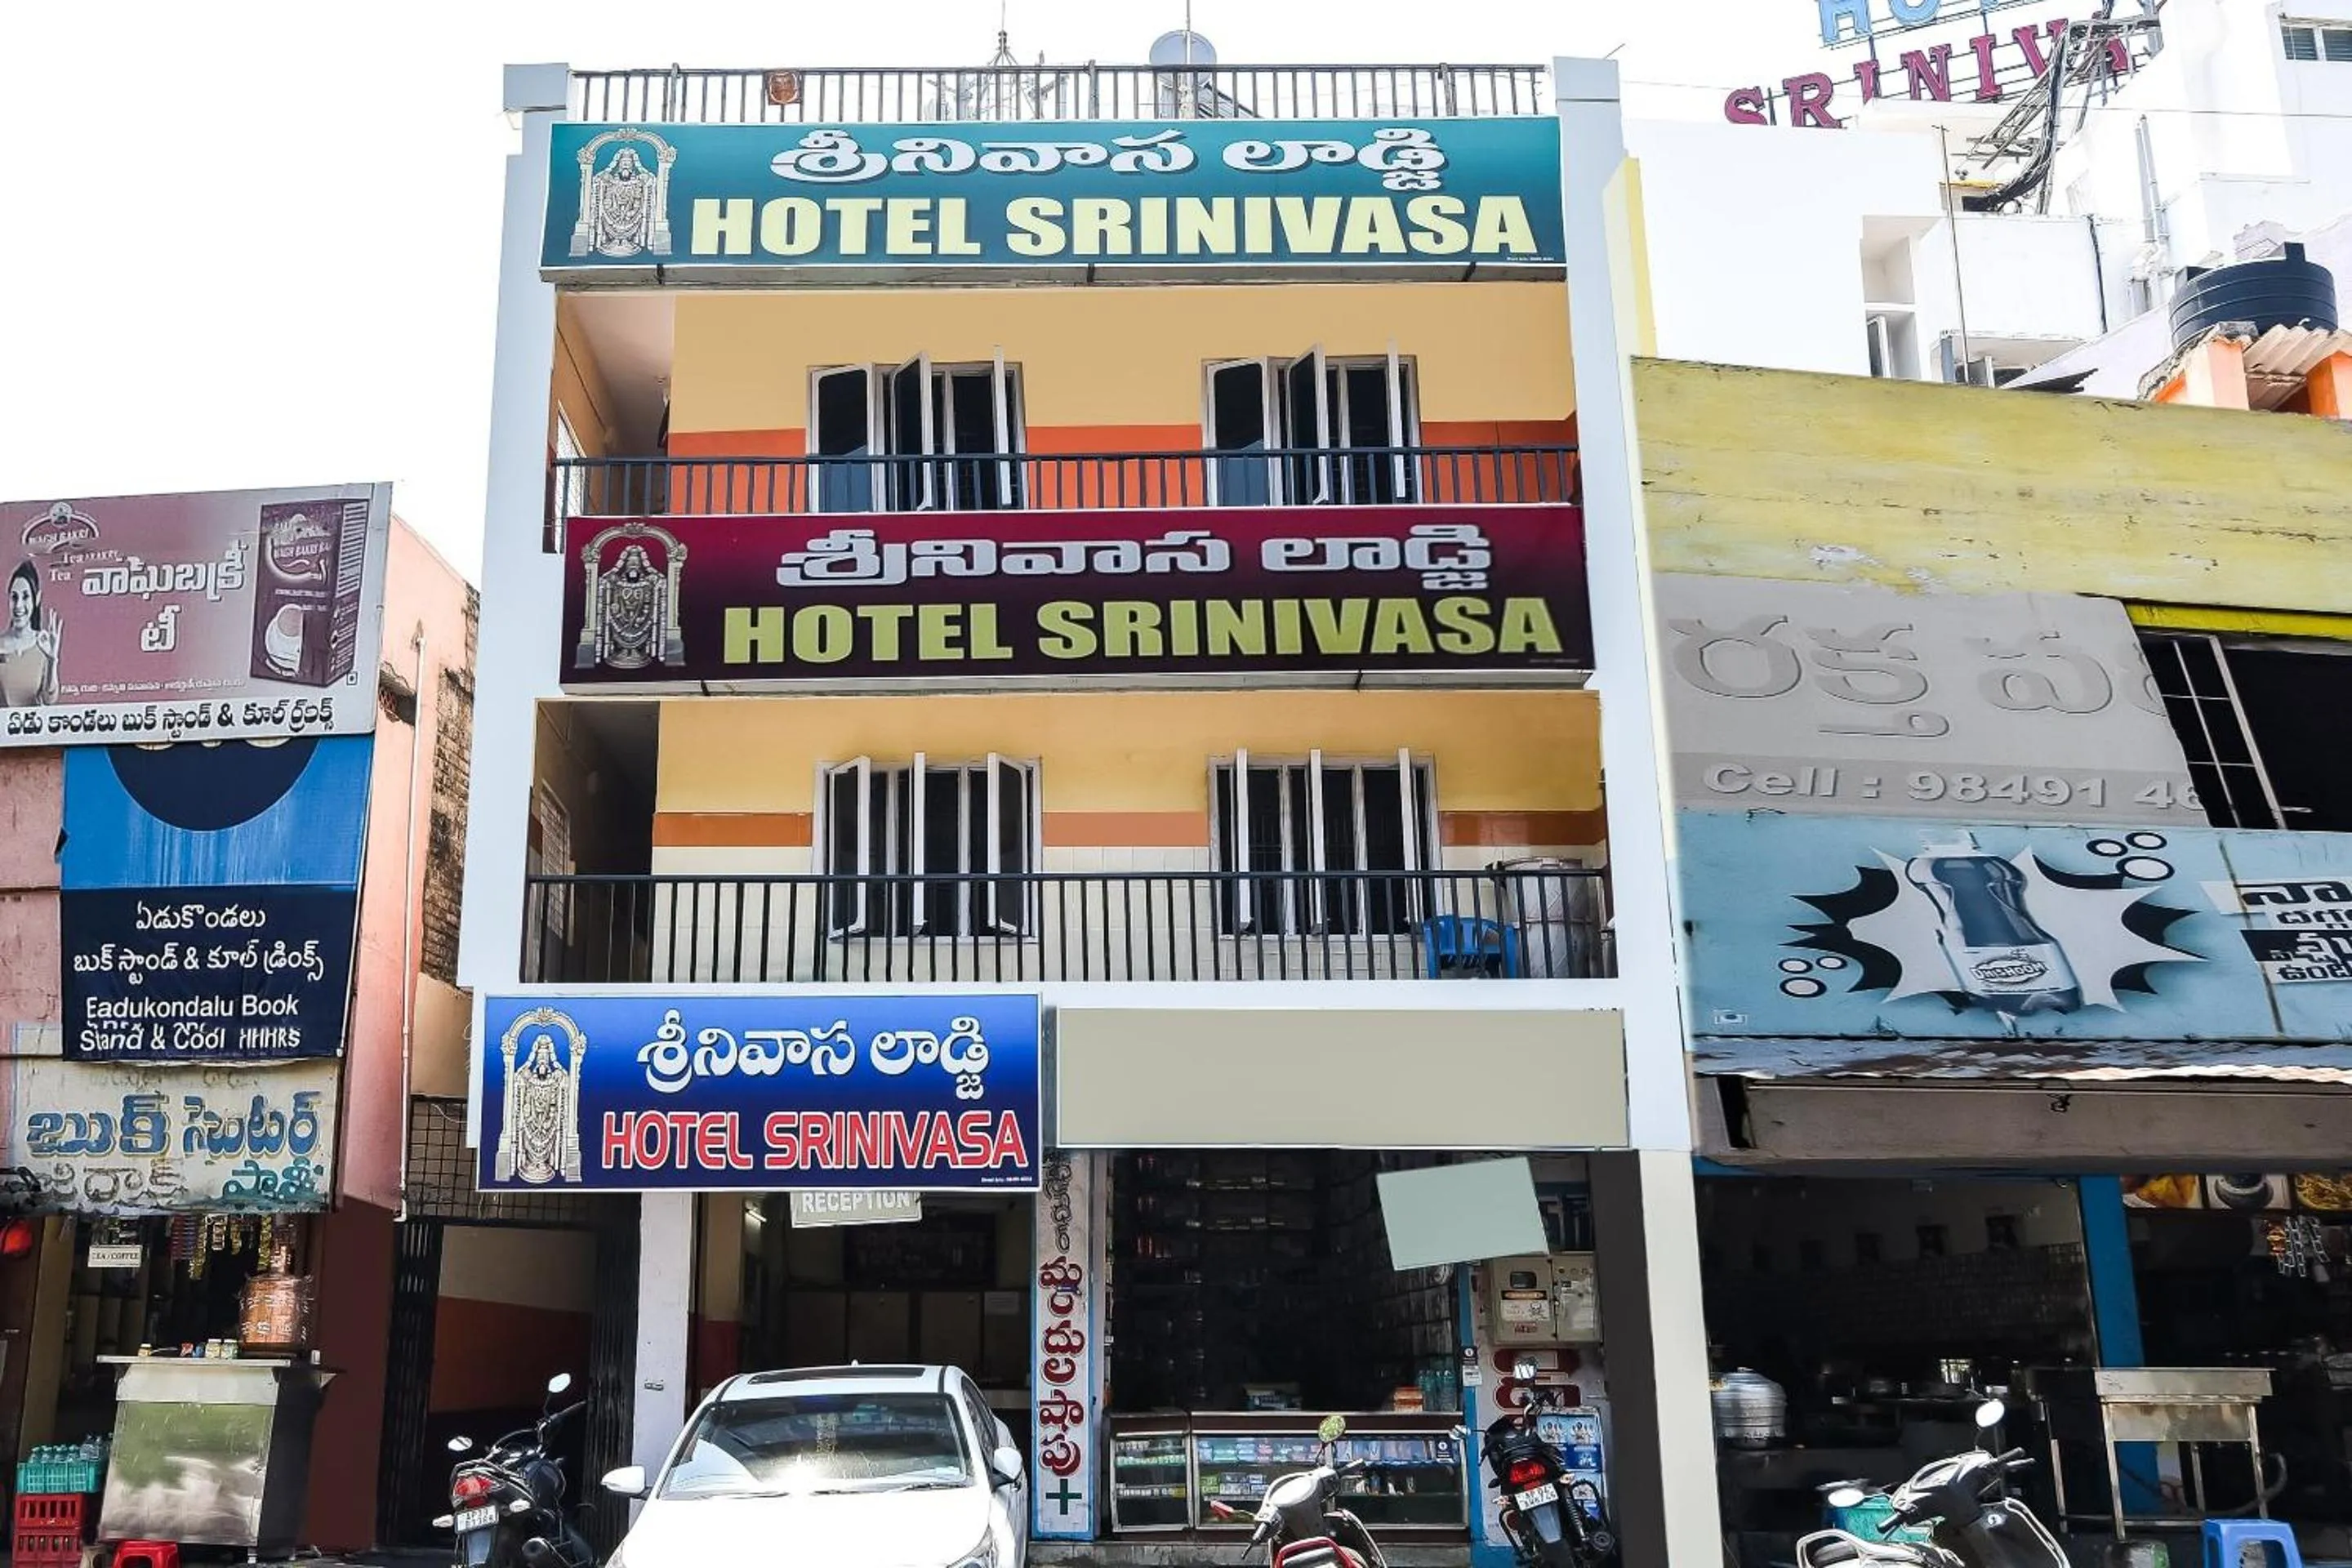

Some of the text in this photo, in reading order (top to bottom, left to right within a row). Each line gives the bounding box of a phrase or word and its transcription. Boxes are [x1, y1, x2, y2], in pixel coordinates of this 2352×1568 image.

[770, 127, 1446, 191] శ్రీనివాస లాడ్జి
[691, 195, 1538, 256] HOTEL SRINIVASA
[776, 523, 1491, 590] శ్రీనివాస లాడ్జి
[723, 596, 1563, 664] HOTEL SRINIVASA
[217, 703, 235, 728] &
[1704, 762, 1840, 798] Cell
[1906, 770, 2107, 808] 98491
[74, 942, 116, 972] బుక్
[184, 947, 199, 970] &
[87, 994, 299, 1019] Eadukondalu Book
[80, 1024, 142, 1052] Stand
[150, 1024, 166, 1050] &
[173, 1024, 226, 1050] Cool
[636, 1008, 990, 1100] శ్రీనివాస లాడ్జి
[601, 1110, 1029, 1169] HOTEL SRINIVASA
[802, 1191, 910, 1214] RECEPTION
